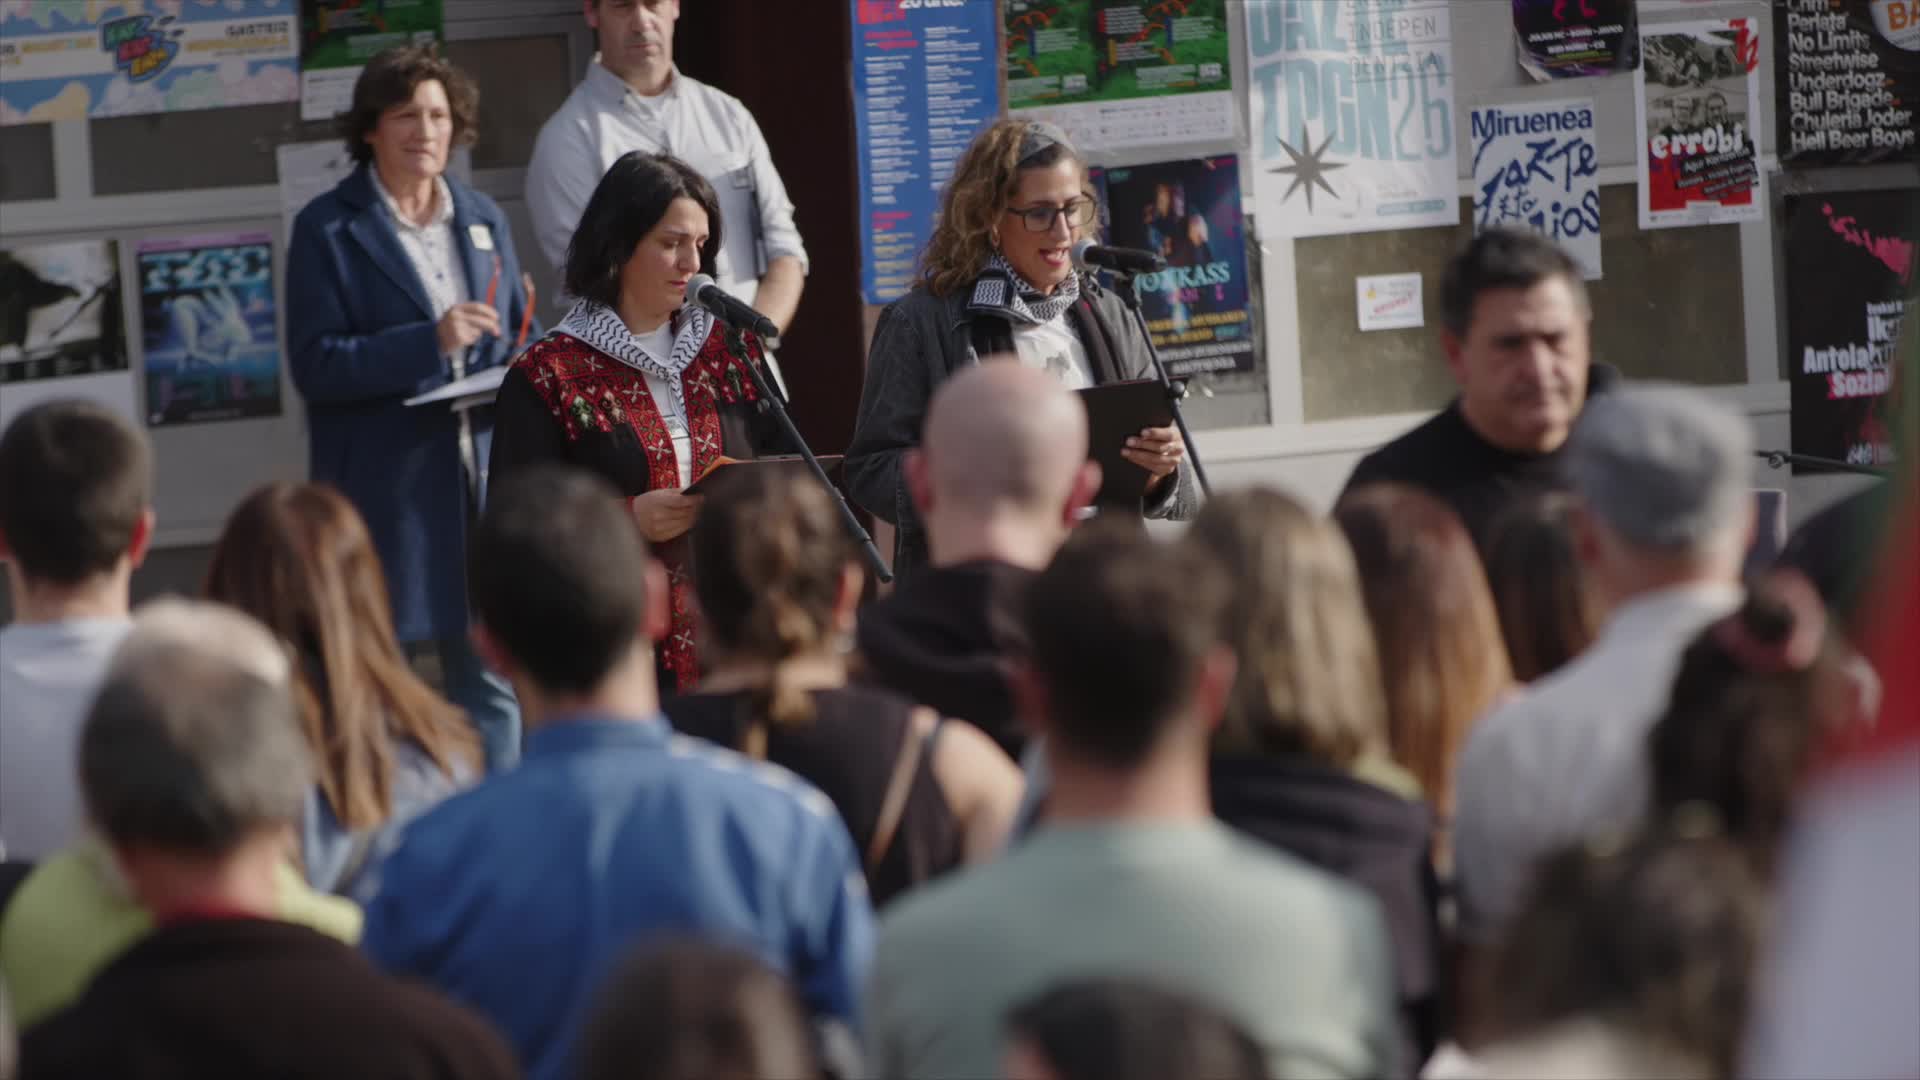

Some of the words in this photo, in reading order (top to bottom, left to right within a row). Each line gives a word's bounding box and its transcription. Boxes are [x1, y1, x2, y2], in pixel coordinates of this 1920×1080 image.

[1788, 32, 1815, 53] No
[1817, 28, 1871, 51] Limits
[1789, 49, 1880, 71] Streetwise
[1789, 70, 1886, 92] Underdogz
[1790, 91, 1823, 112] Bull
[1825, 88, 1893, 112] Brigade
[1471, 109, 1593, 138] Miruenea
[1864, 107, 1912, 128] Joder
[1652, 123, 1744, 159] errobi
[1791, 130, 1826, 152] Hell
[1828, 129, 1869, 150] Beer
[1871, 127, 1915, 151] Boys
